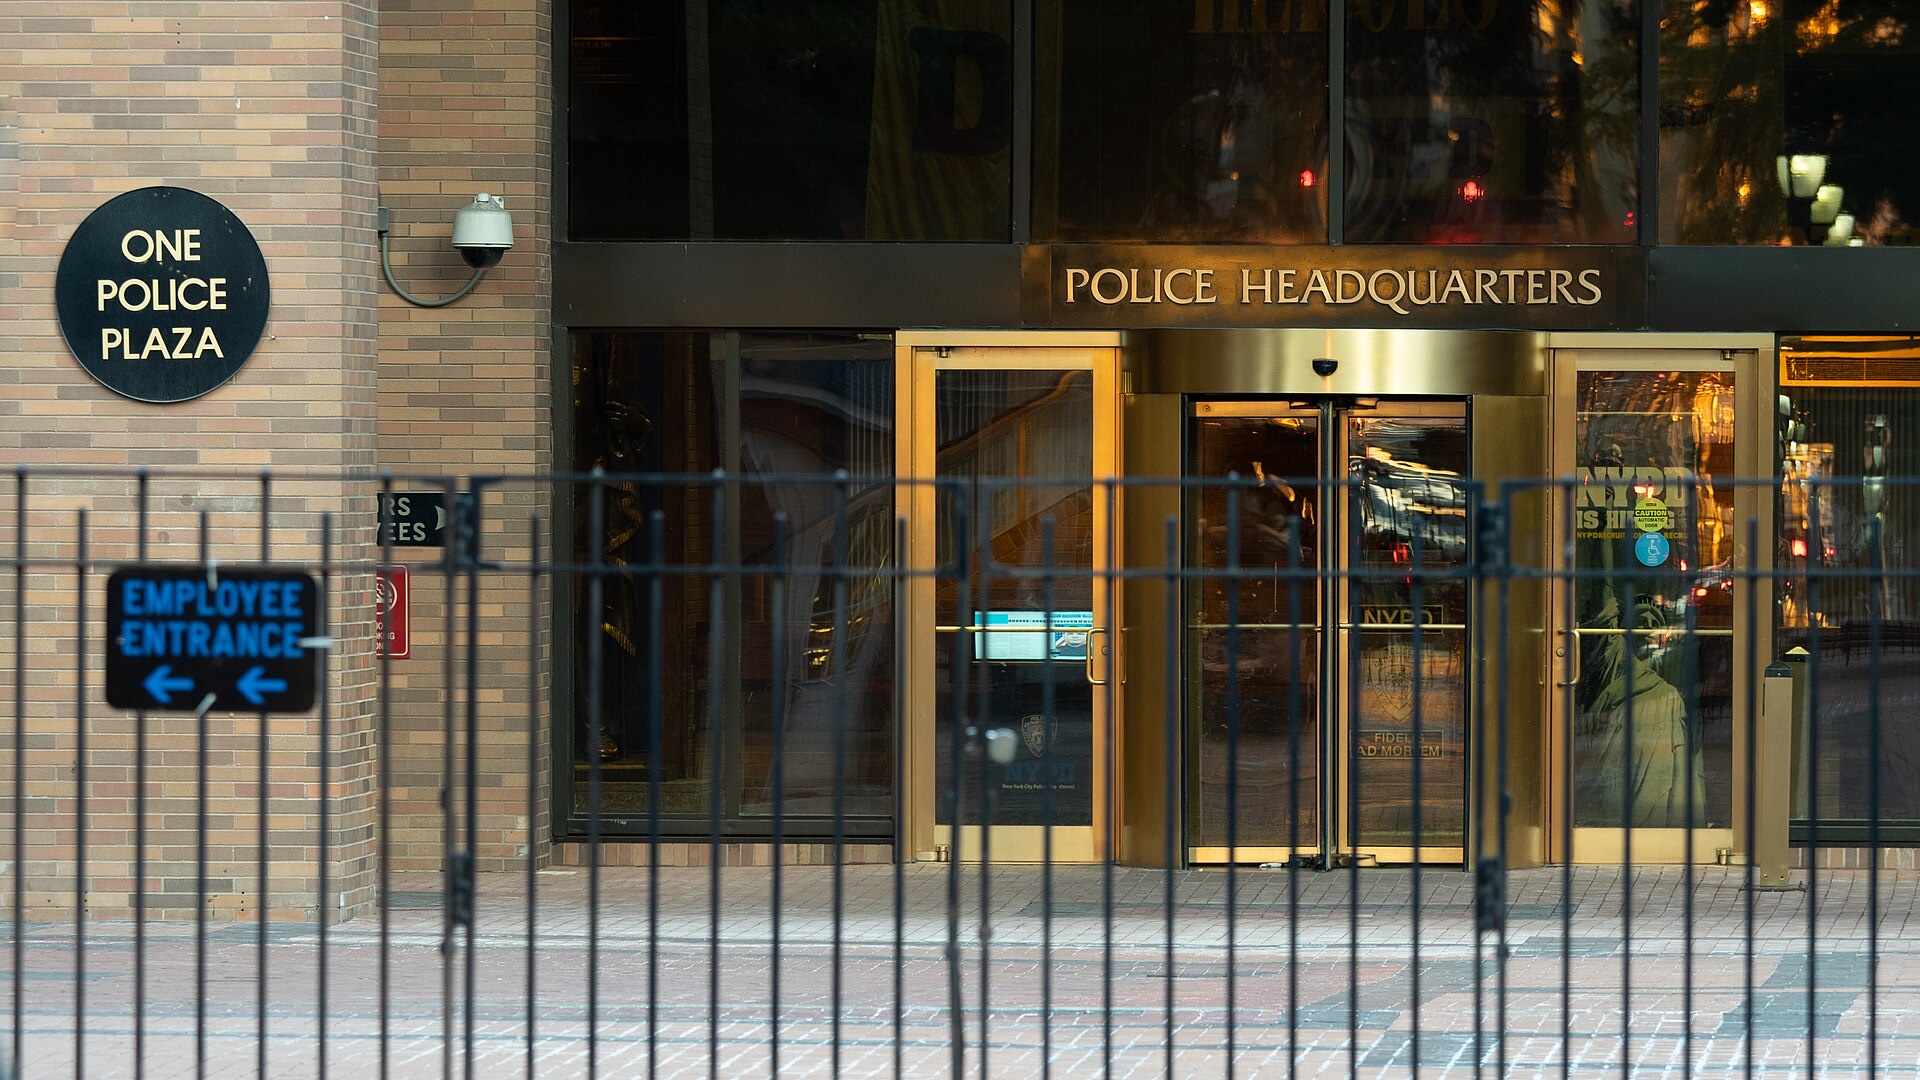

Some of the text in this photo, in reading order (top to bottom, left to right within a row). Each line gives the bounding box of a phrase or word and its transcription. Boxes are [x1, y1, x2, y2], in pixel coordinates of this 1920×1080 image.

[121, 229, 201, 263] ONE
[97, 277, 227, 312] POLICE
[1065, 268, 1602, 315] POLICE HEADQUARTERS
[101, 326, 225, 360] PLAZA
[1576, 466, 1694, 507] NYPD
[1576, 510, 1675, 529] IS HIG
[122, 579, 304, 618] EMPLOYEE
[1364, 609, 1434, 625] NYPD
[120, 619, 304, 658] ENTRANCE
[1357, 745, 1440, 756] AD MOREM
[1375, 732, 1425, 743] FIDELS
